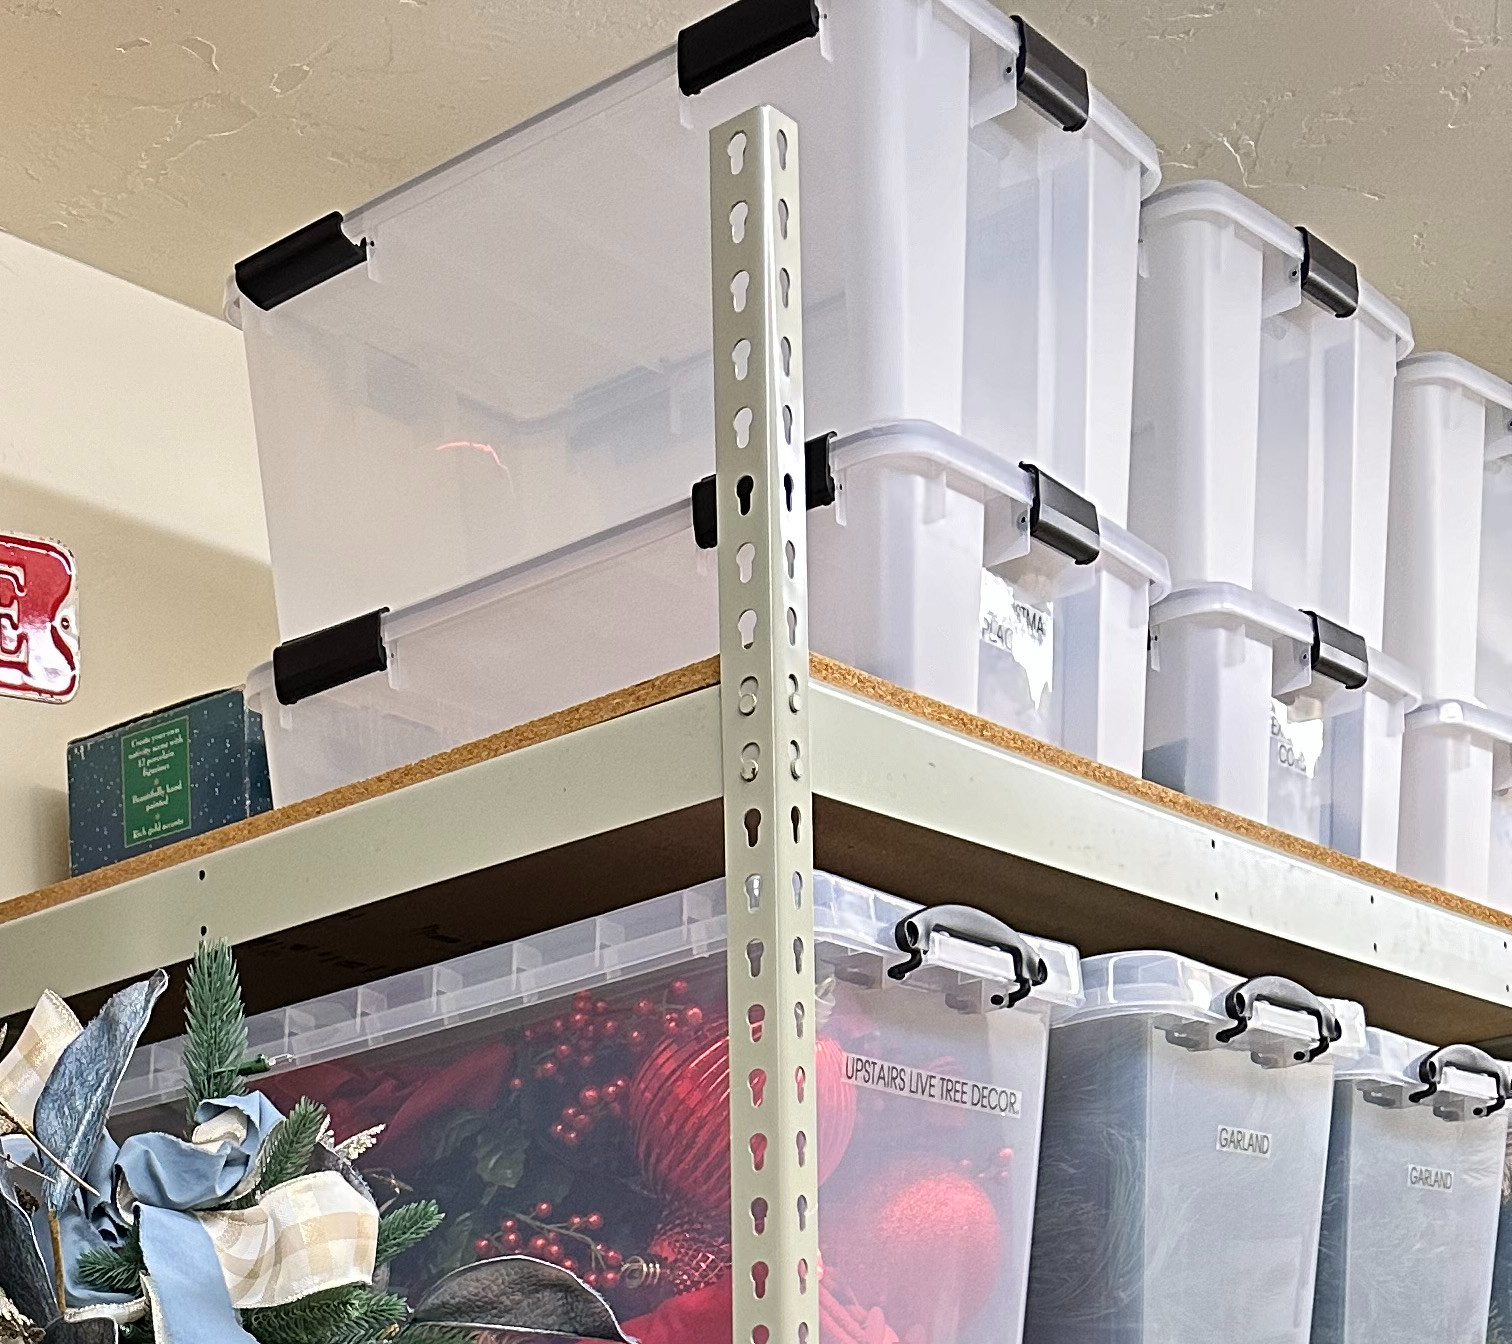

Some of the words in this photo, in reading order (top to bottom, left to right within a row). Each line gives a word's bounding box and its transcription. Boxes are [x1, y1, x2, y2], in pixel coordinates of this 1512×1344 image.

[845, 1056, 906, 1092] UPSTAIRS
[909, 1072, 937, 1098] LIVE
[940, 1077, 968, 1104] TREE
[1219, 1128, 1270, 1155] GARLAND
[1409, 1166, 1453, 1190] GARLAND
